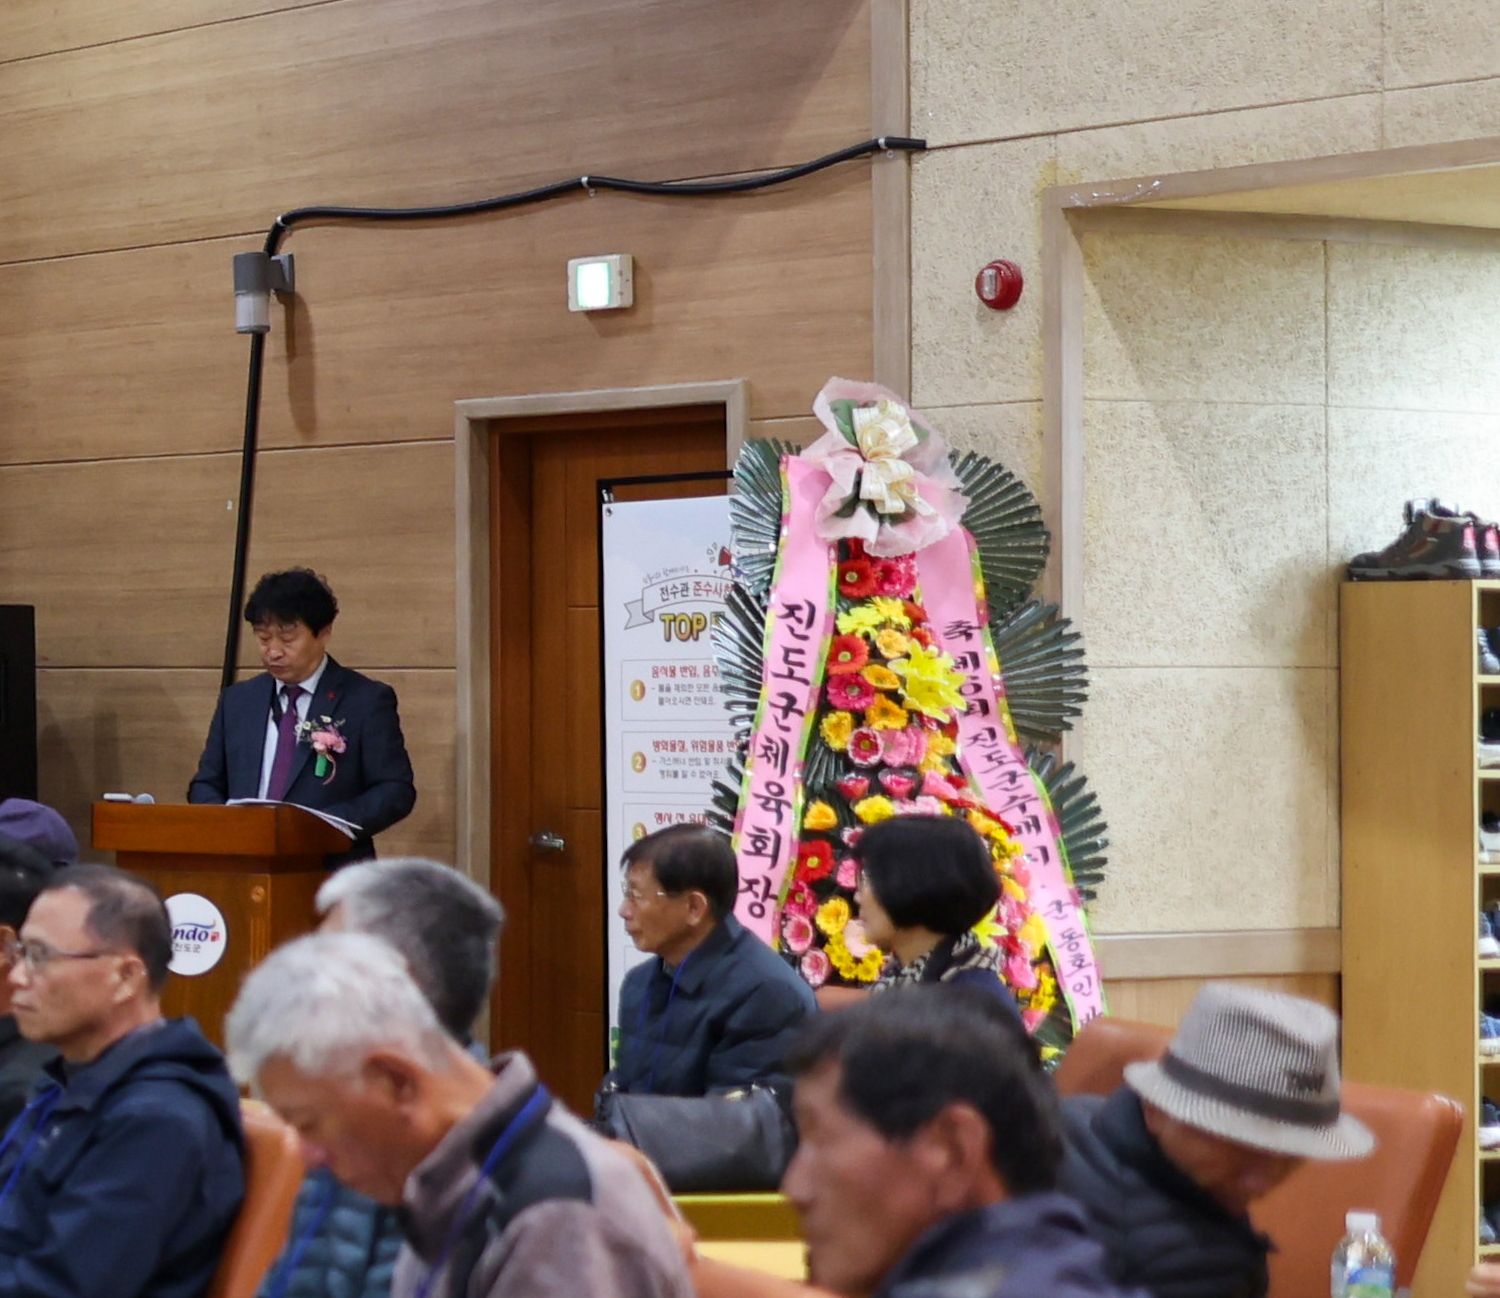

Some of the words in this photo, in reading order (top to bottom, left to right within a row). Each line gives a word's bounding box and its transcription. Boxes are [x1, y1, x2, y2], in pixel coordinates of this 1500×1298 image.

[659, 581, 690, 602] 전수관
[659, 612, 707, 642] TOP
[738, 599, 816, 919] 진도군체육회장
[173, 927, 209, 942] ndo
